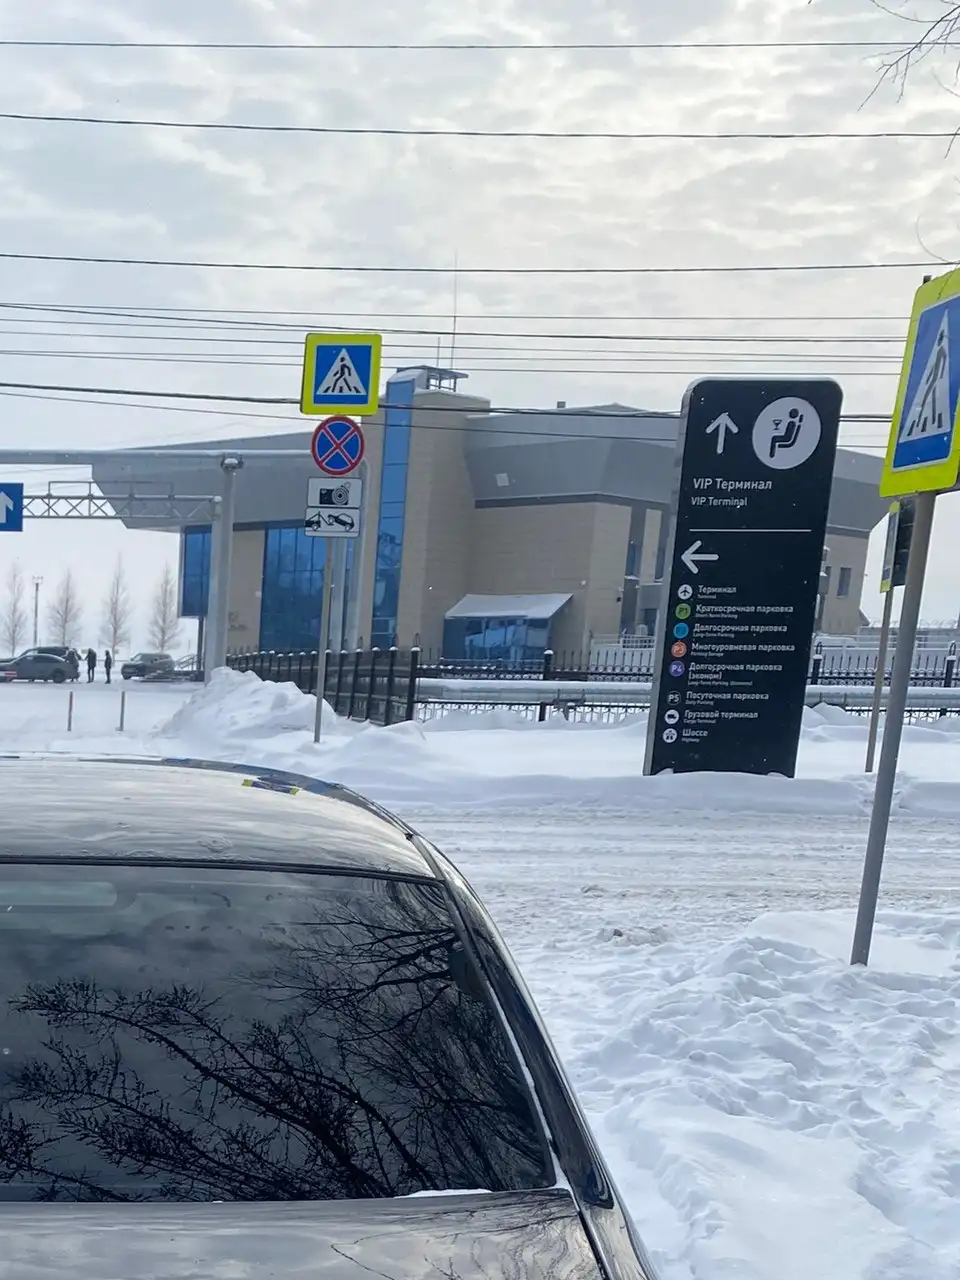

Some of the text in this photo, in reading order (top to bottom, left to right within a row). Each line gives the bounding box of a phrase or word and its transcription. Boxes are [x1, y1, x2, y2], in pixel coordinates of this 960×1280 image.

[693, 478, 773, 492] VIP Терминал
[691, 496, 747, 506] VIP Terminal
[698, 584, 737, 595] Терминал
[695, 604, 756, 614] Краткосрочная
[756, 605, 794, 614] парковка
[693, 623, 749, 633] Долгосрочная
[750, 624, 788, 633] парковка
[691, 643, 757, 653] Многоуровневая
[757, 644, 795, 653] парковка
[671, 662, 783, 673] P4 Долгосрочная парковка
[669, 691, 769, 702] P5 Посуточная парковка
[684, 709, 759, 719] Грузовой терминал
[682, 729, 708, 737] Шоссе
